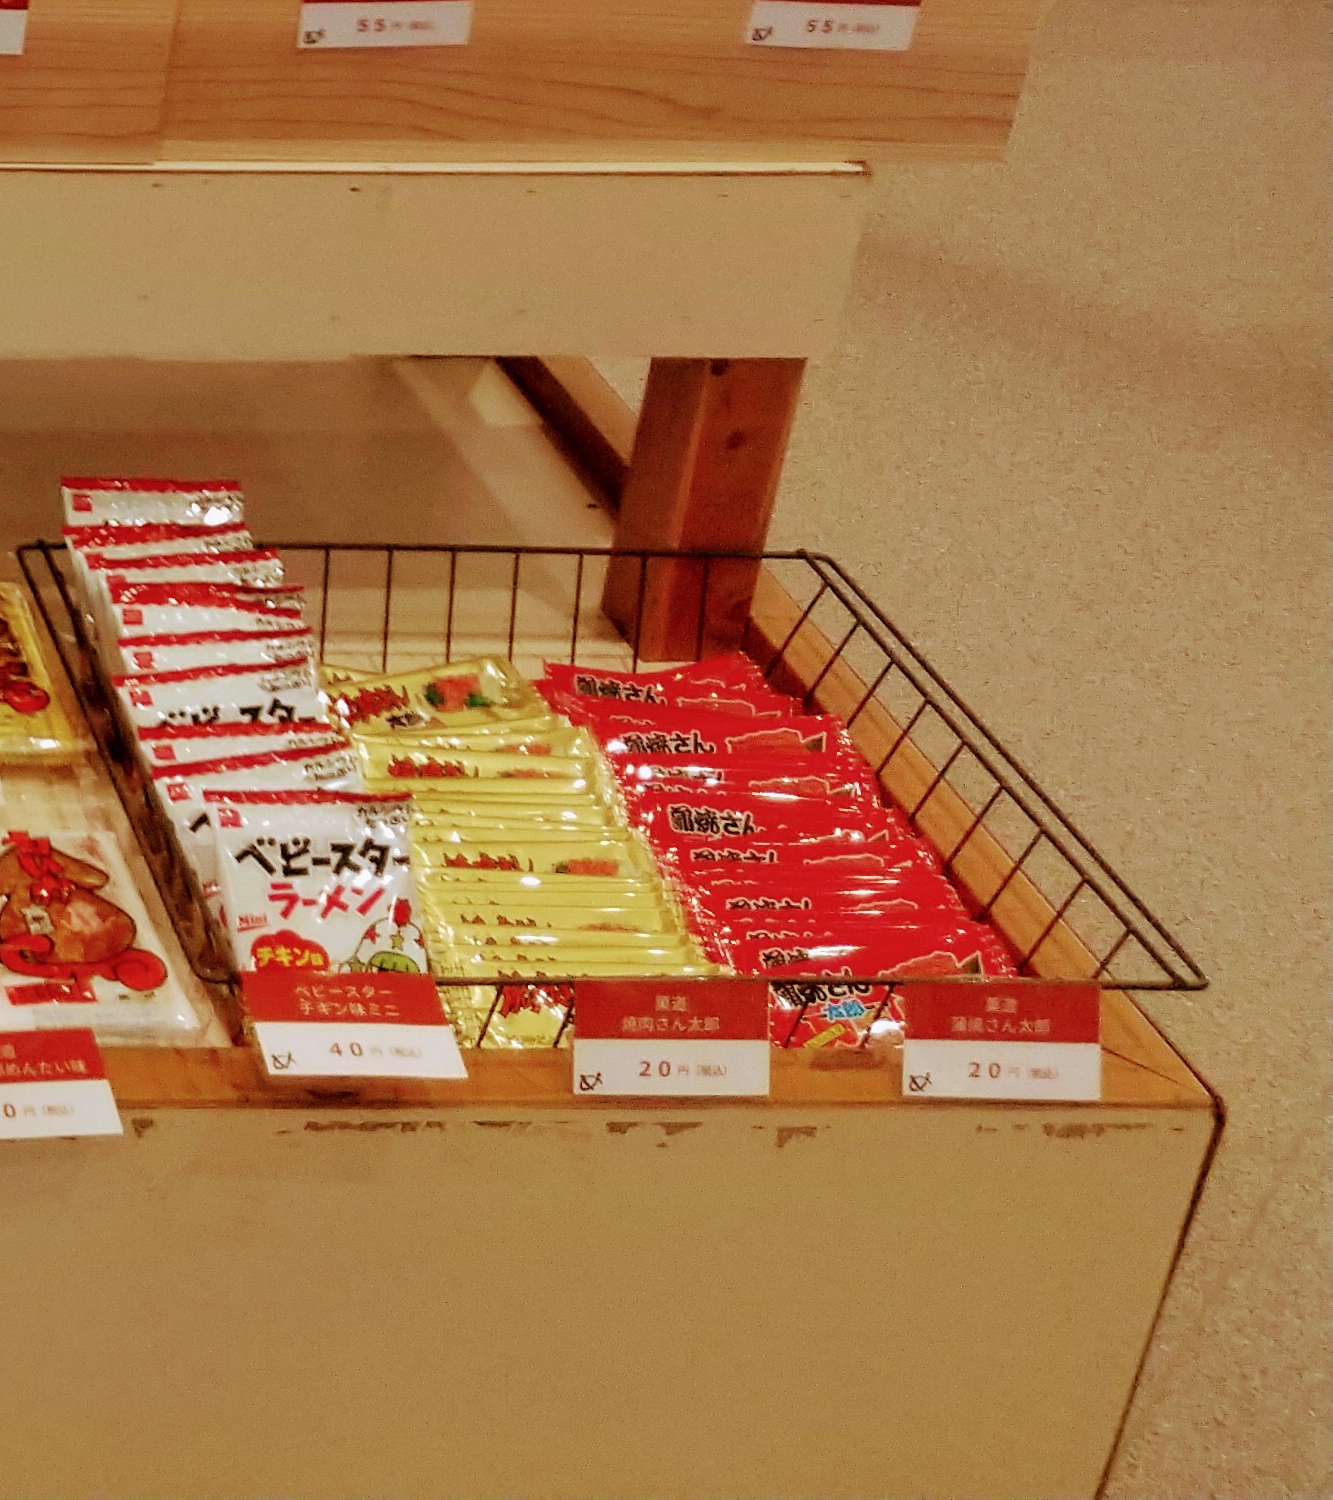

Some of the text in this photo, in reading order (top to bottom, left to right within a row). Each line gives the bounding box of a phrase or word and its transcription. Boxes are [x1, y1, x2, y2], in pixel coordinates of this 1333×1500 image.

[236, 837, 410, 877] ベビースター
[267, 882, 386, 921] ラーメン
[294, 985, 394, 999] ベビースター
[299, 1001, 401, 1018] チキン味ミニ
